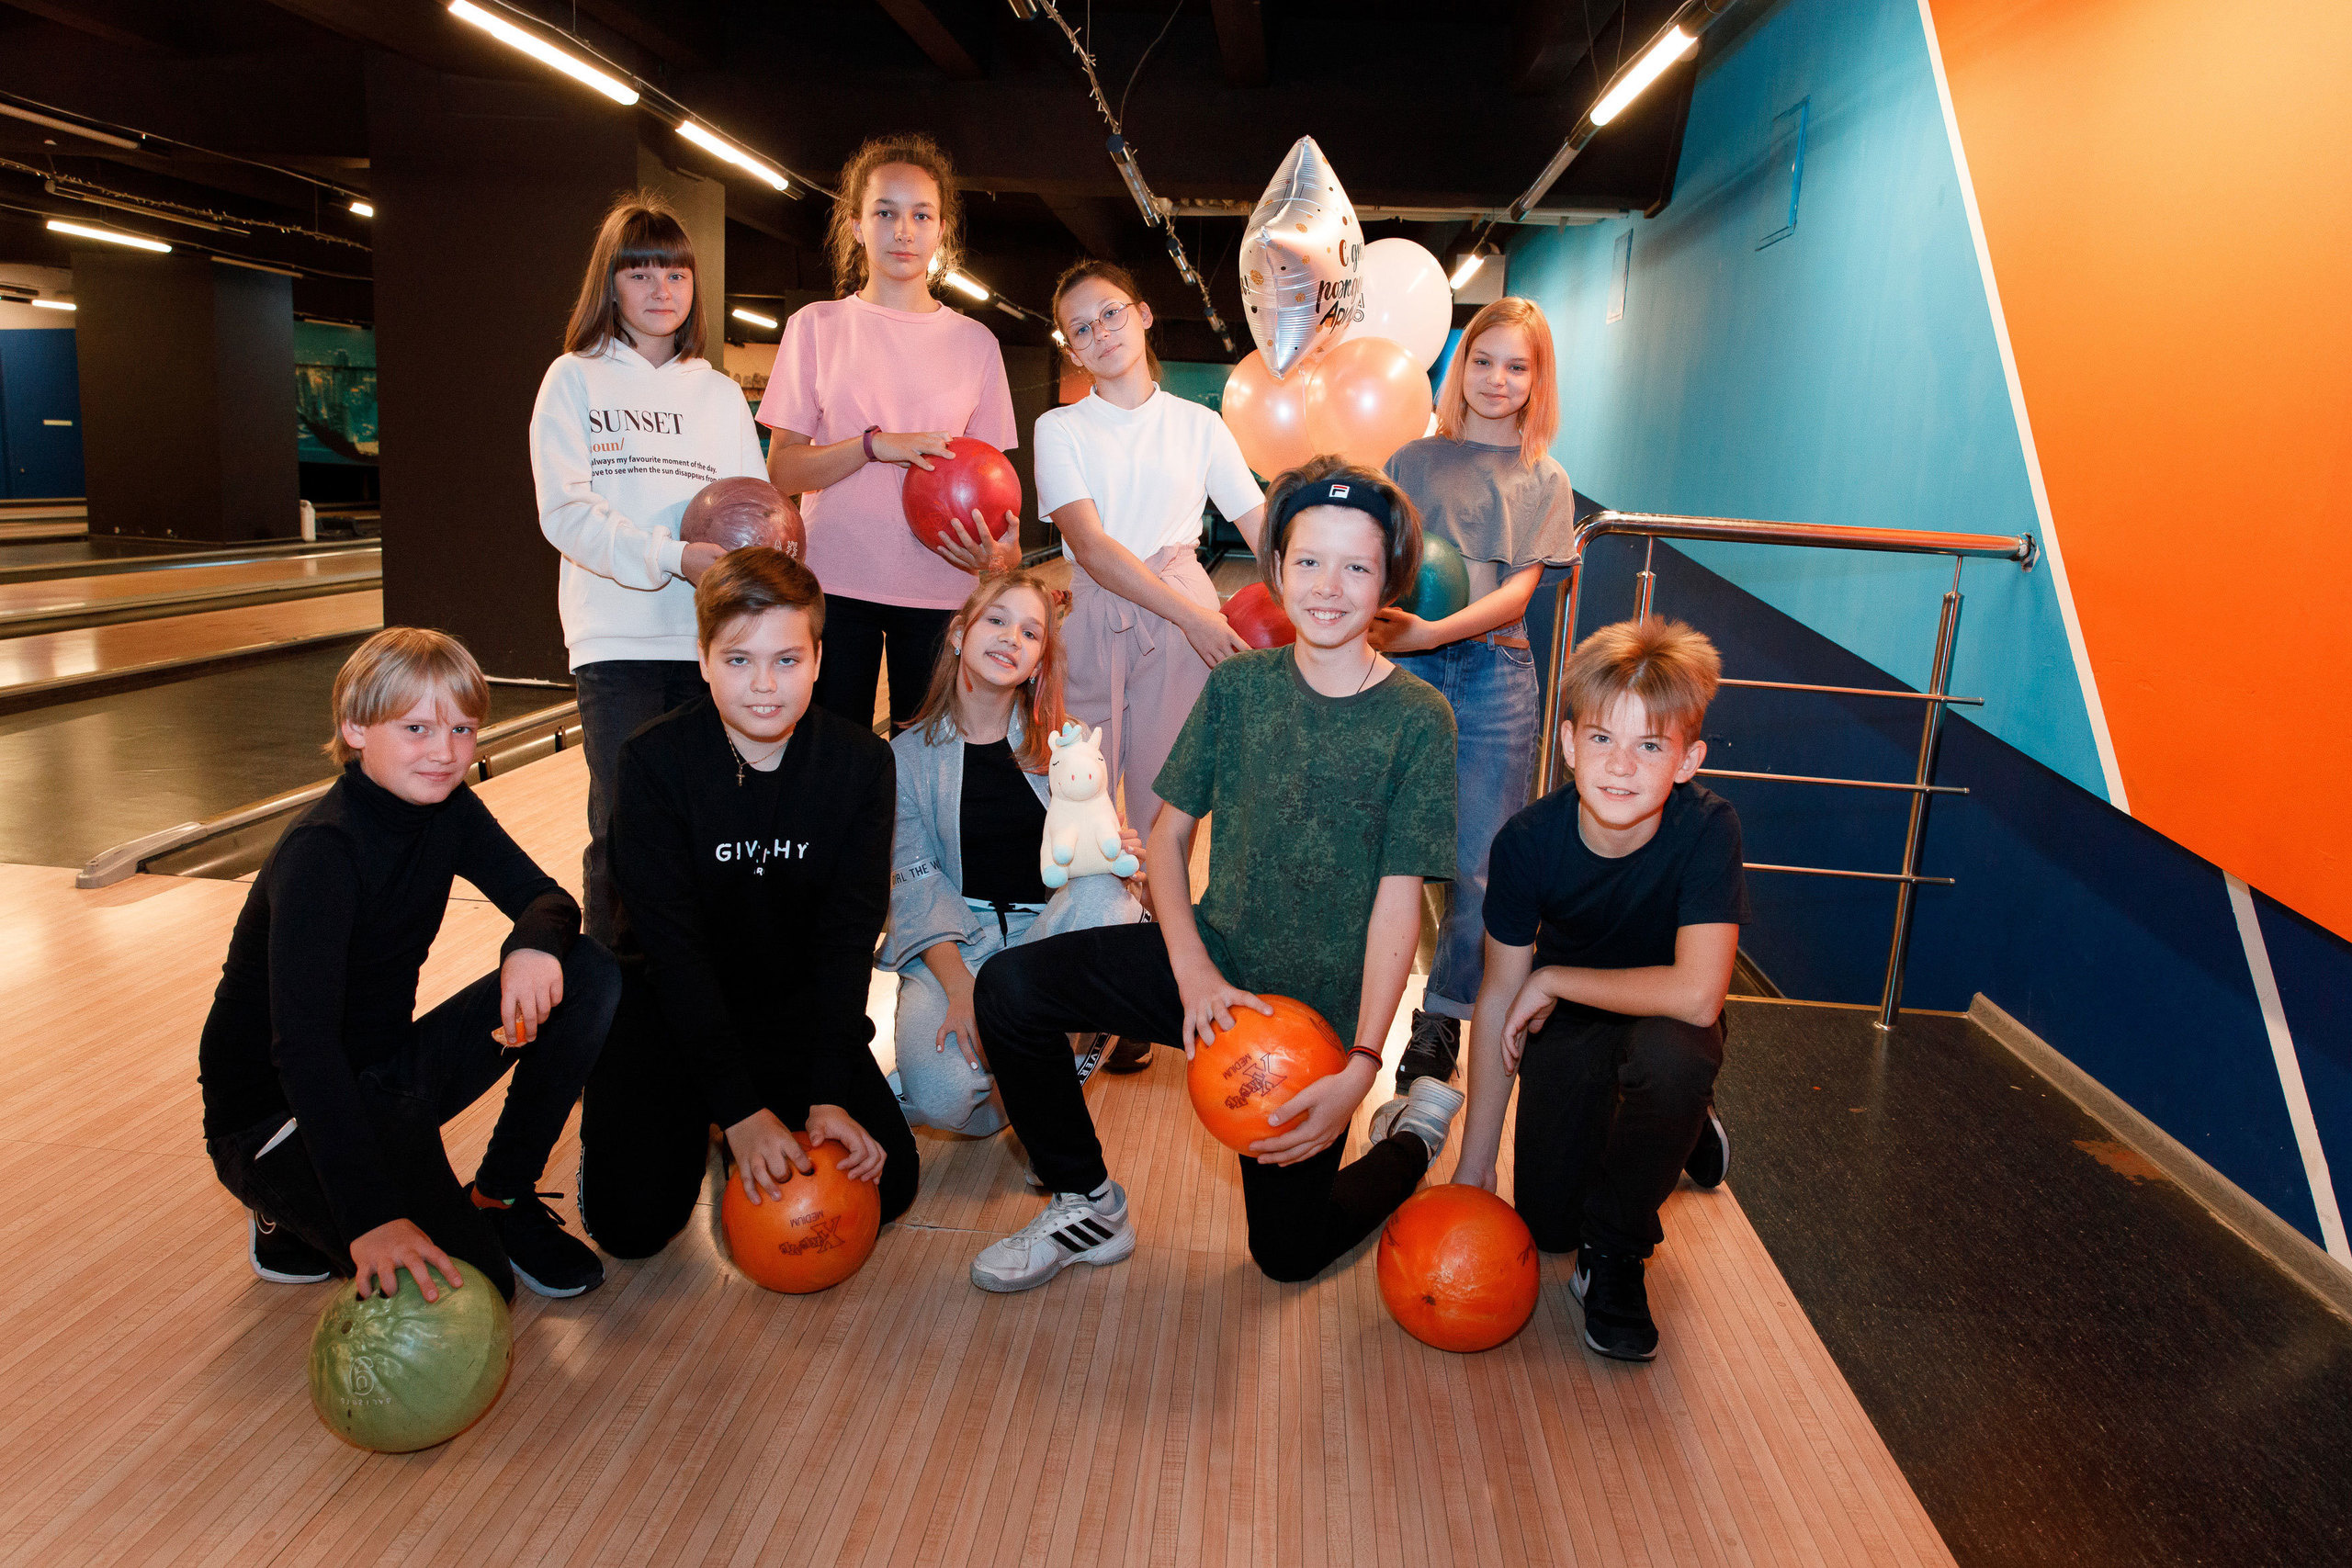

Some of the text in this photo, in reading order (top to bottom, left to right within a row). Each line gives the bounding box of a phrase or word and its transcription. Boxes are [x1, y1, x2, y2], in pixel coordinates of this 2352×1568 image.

[589, 409, 684, 434] SUNSET
[590, 436, 625, 453] oun/
[628, 455, 662, 464] favourite
[662, 457, 690, 467] moment
[696, 461, 707, 470] the
[627, 466, 648, 474] when
[674, 468, 706, 481] disappears
[908, 863, 930, 878] THE
[1222, 1053, 1253, 1080] MEDIUM
[789, 1209, 824, 1228] MEDIUM
